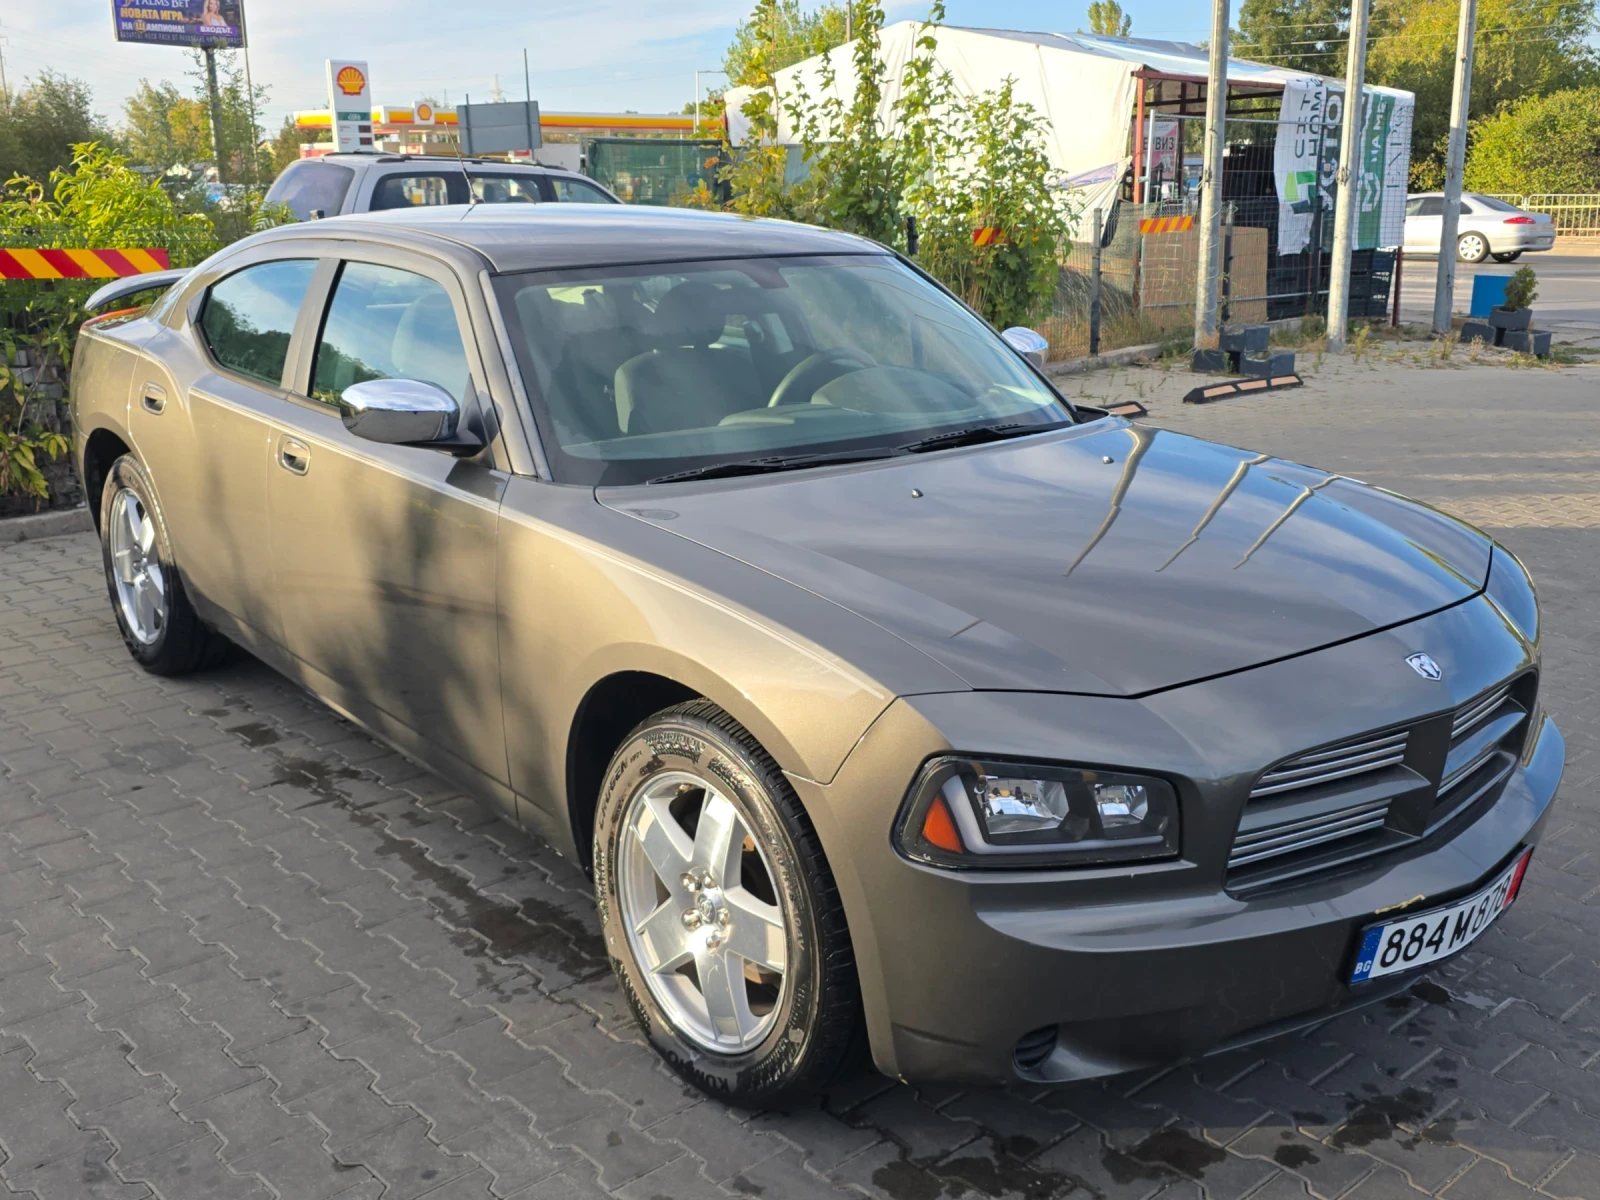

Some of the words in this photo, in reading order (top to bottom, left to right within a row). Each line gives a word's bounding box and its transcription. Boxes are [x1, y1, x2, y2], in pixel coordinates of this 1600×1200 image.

[120, 8, 159, 19] НОВАТА
[160, 10, 184, 21] ИГРА
[1143, 136, 1175, 150] ЕВИЗ
[1354, 960, 1372, 975] BG
